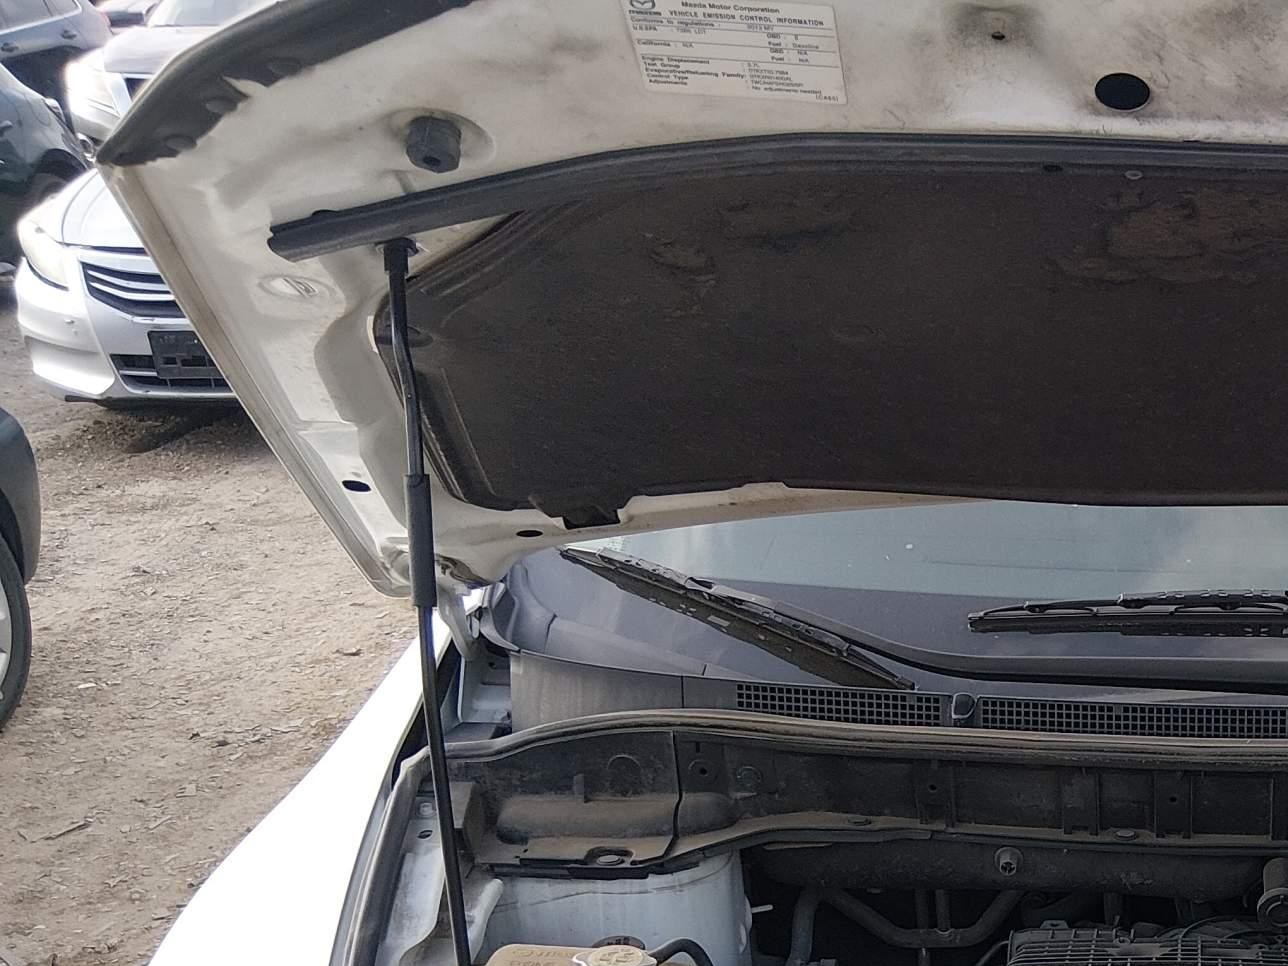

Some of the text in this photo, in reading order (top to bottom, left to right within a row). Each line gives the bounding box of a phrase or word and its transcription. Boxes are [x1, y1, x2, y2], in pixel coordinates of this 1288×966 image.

[681, 1, 706, 9] Mazda
[733, 4, 780, 13] Corporation
[740, 14, 773, 23] CONTROL
[776, 17, 824, 26] INFORMATION
[637, 39, 671, 47] California
